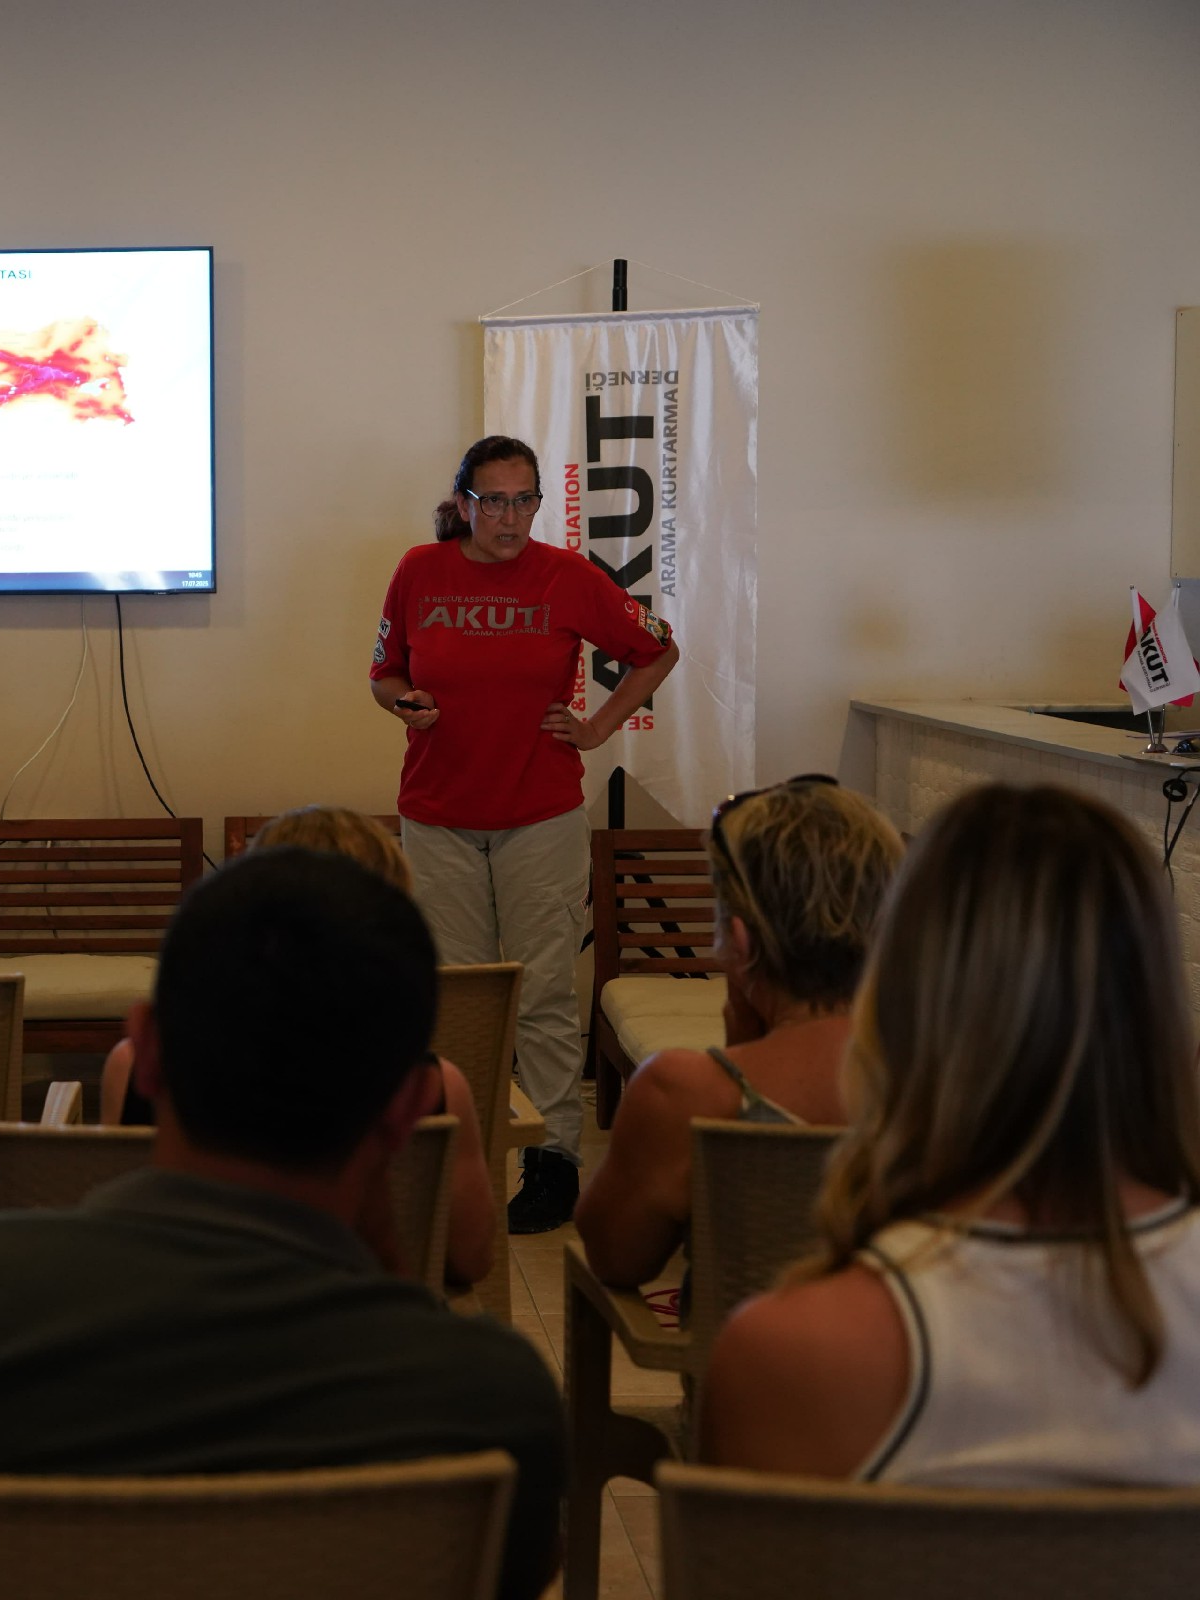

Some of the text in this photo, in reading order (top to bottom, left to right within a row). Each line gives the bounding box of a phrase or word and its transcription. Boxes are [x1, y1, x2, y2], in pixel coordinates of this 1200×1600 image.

[661, 388, 679, 597] ARAMA KURTARMA
[564, 463, 582, 551] CIATION
[464, 596, 519, 604] ASSOCIATION
[420, 605, 541, 629] AKUT
[462, 629, 494, 637] ARAMA
